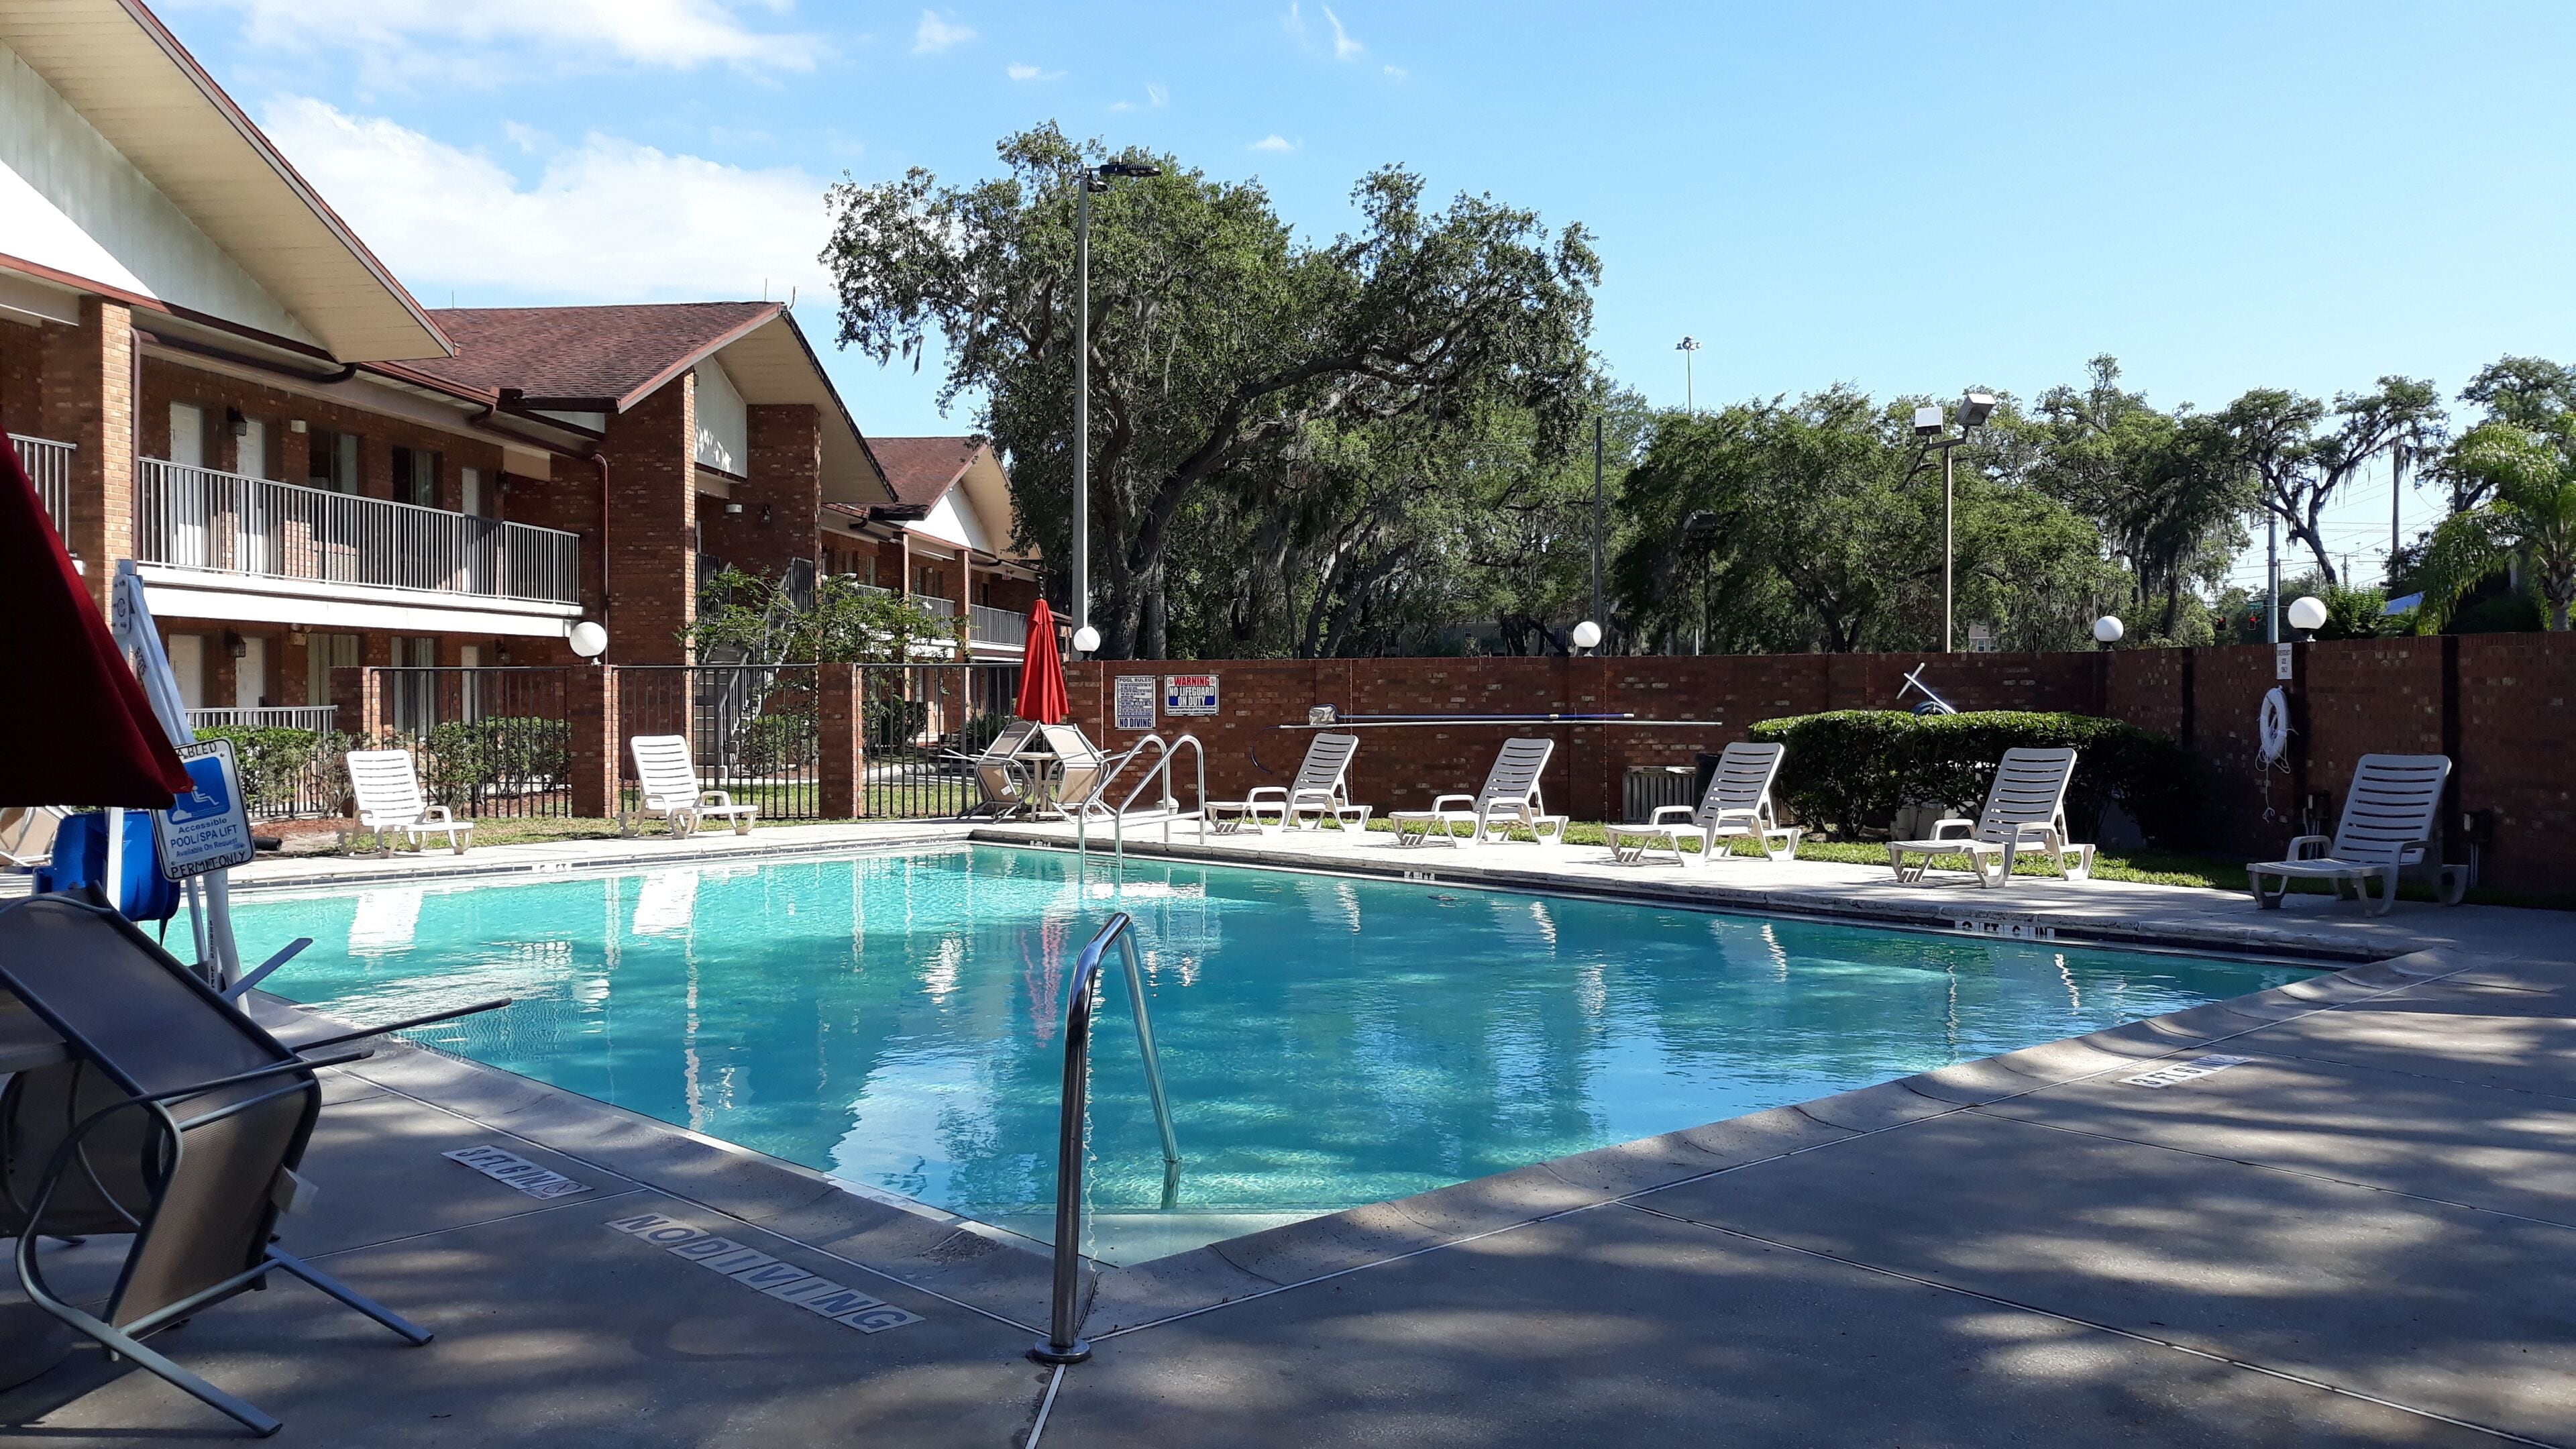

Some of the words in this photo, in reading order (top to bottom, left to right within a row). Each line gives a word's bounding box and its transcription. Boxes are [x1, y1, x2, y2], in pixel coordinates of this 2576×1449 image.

[1174, 676, 1210, 686] WARNING
[1169, 686, 1179, 697] NO
[1179, 686, 1214, 697] LIFEGUARD
[1178, 696, 1187, 706] ON
[1188, 696, 1205, 706] DUTY
[1119, 718, 1128, 728] NO
[1130, 718, 1152, 728] DIVING
[178, 817, 227, 834] Accessible
[170, 830, 219, 849] POOL/SPA
[219, 824, 237, 838] LIFT
[176, 846, 203, 858] Available
[214, 838, 238, 849] Request
[2146, 1071, 2188, 1083] FT
[469, 1154, 518, 1168] FT
[494, 1165, 533, 1174] 6
[616, 1215, 696, 1241] NO
[678, 1240, 908, 1330] DIVING
